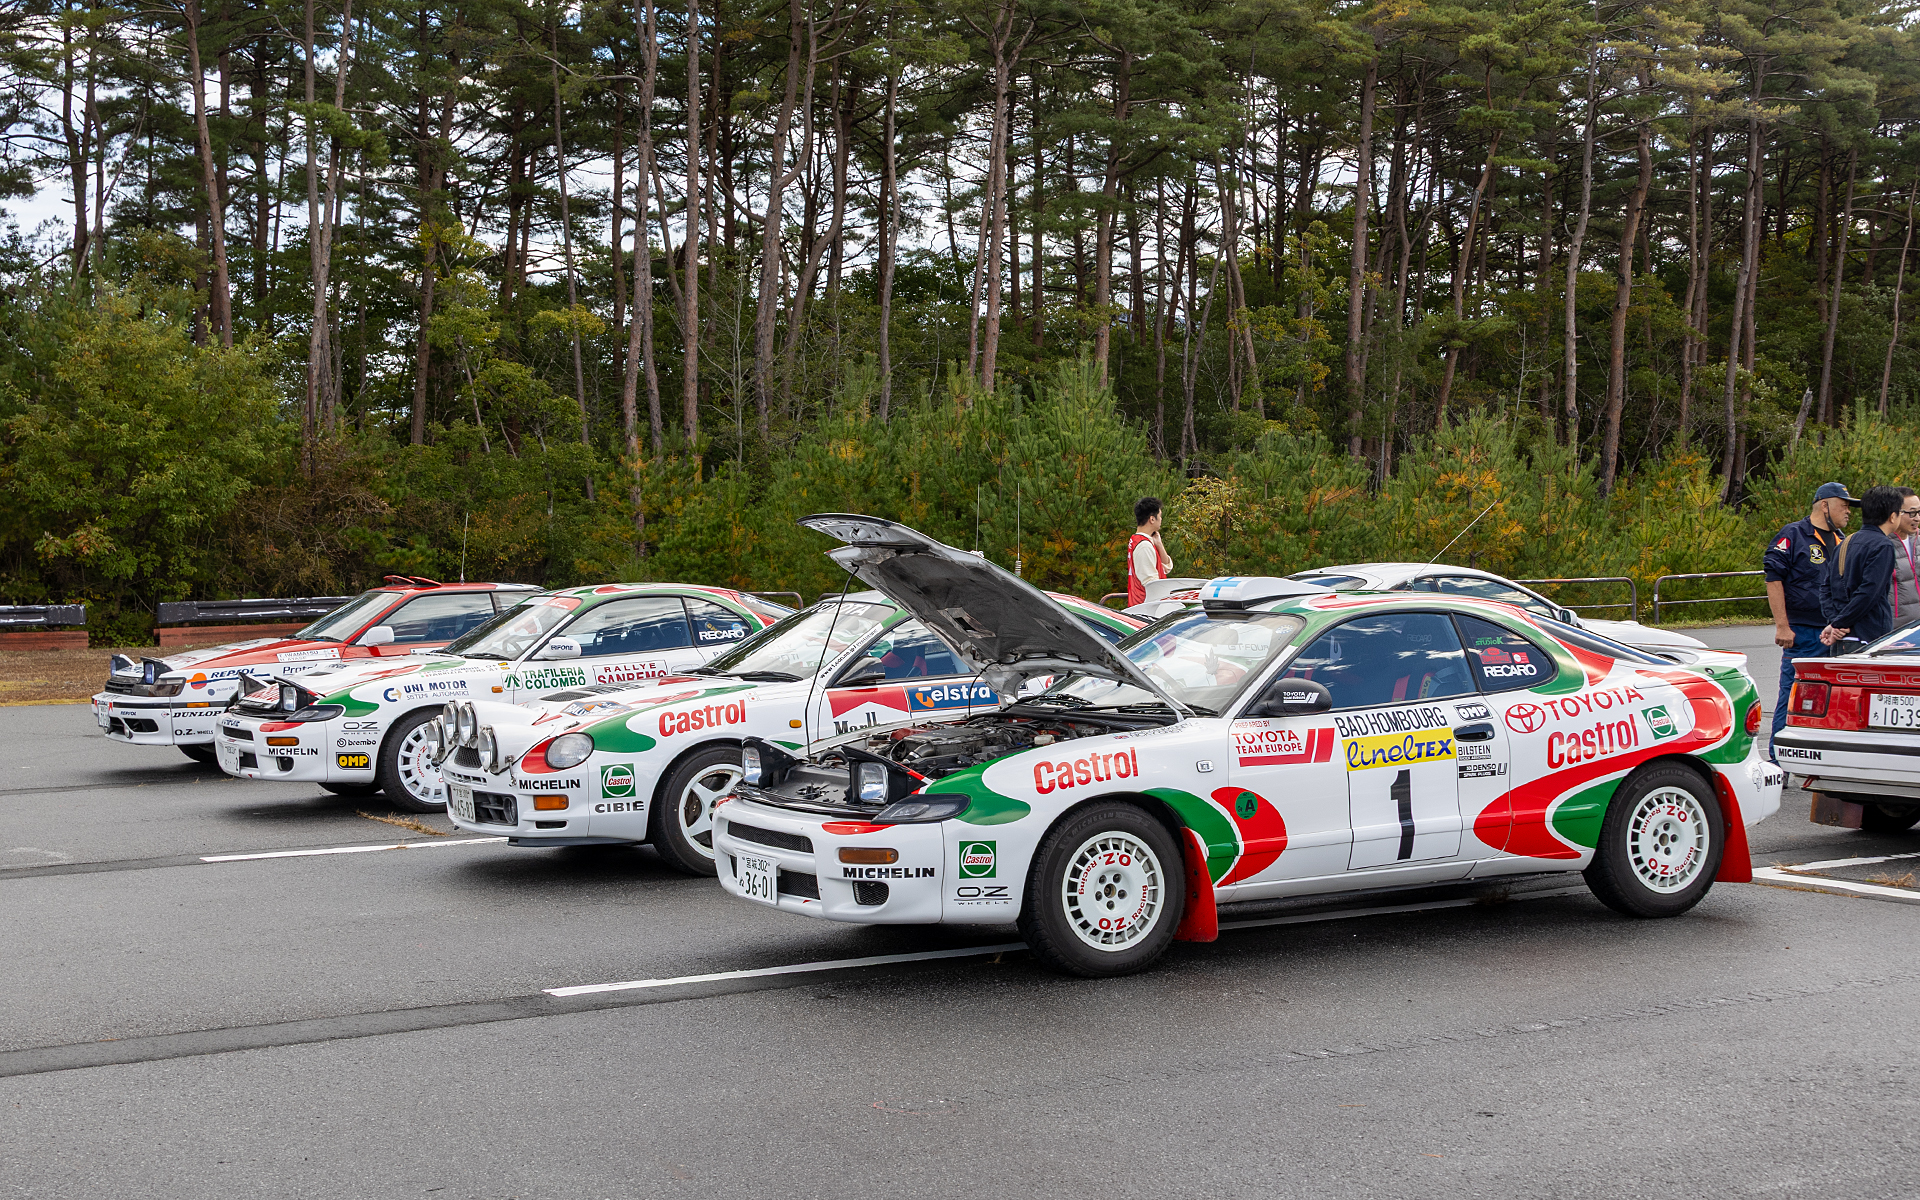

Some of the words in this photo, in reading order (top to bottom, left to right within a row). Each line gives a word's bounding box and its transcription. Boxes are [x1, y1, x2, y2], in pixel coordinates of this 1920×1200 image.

[698, 629, 745, 641] RECARO
[211, 668, 255, 679] REPSOL
[522, 667, 586, 679] TRAFILERIA
[603, 662, 657, 673] RALLYE
[1483, 664, 1537, 678] RECARO
[403, 683, 424, 693] UNI
[429, 680, 468, 690] MOTOR
[525, 676, 587, 690] COLOMBO
[916, 685, 991, 703] Telstra
[1542, 686, 1645, 721] TOYOTA
[1883, 696, 1915, 706] 湘南500
[173, 710, 222, 718] DUNLOP
[659, 699, 746, 737] Castrol
[1458, 706, 1487, 719] OMP
[1334, 714, 1369, 738] BAD
[1367, 706, 1448, 735] HOMBOURG
[1652, 717, 1671, 727] Castrol
[1231, 729, 1300, 745] TOYOTA
[1546, 713, 1639, 770] Castrol
[268, 748, 319, 756] MICHELIN
[1235, 745, 1263, 754] TEAM
[1266, 742, 1303, 753] EUROPE
[1458, 745, 1491, 756] BILSTEIN
[1778, 747, 1822, 761] MICHELIN
[338, 756, 369, 767] OMP
[1472, 763, 1497, 771] DENSO
[1033, 747, 1139, 795] Castrol
[518, 778, 581, 790] MICHELIN
[608, 777, 632, 786] Castrol
[1764, 773, 1783, 787] MIC
[594, 800, 645, 814] CIBIE
[1245, 799, 1256, 812] A
[1390, 769, 1415, 860] 1
[1641, 807, 1661, 834] Racing
[1071, 812, 1114, 836] MICHELIN
[965, 855, 993, 864] Castrol
[1674, 846, 1695, 873] Racing
[843, 867, 935, 879] MICHELIN
[1078, 860, 1098, 895] Racing
[745, 871, 773, 901] 36-01
[1131, 884, 1149, 920] Racing
